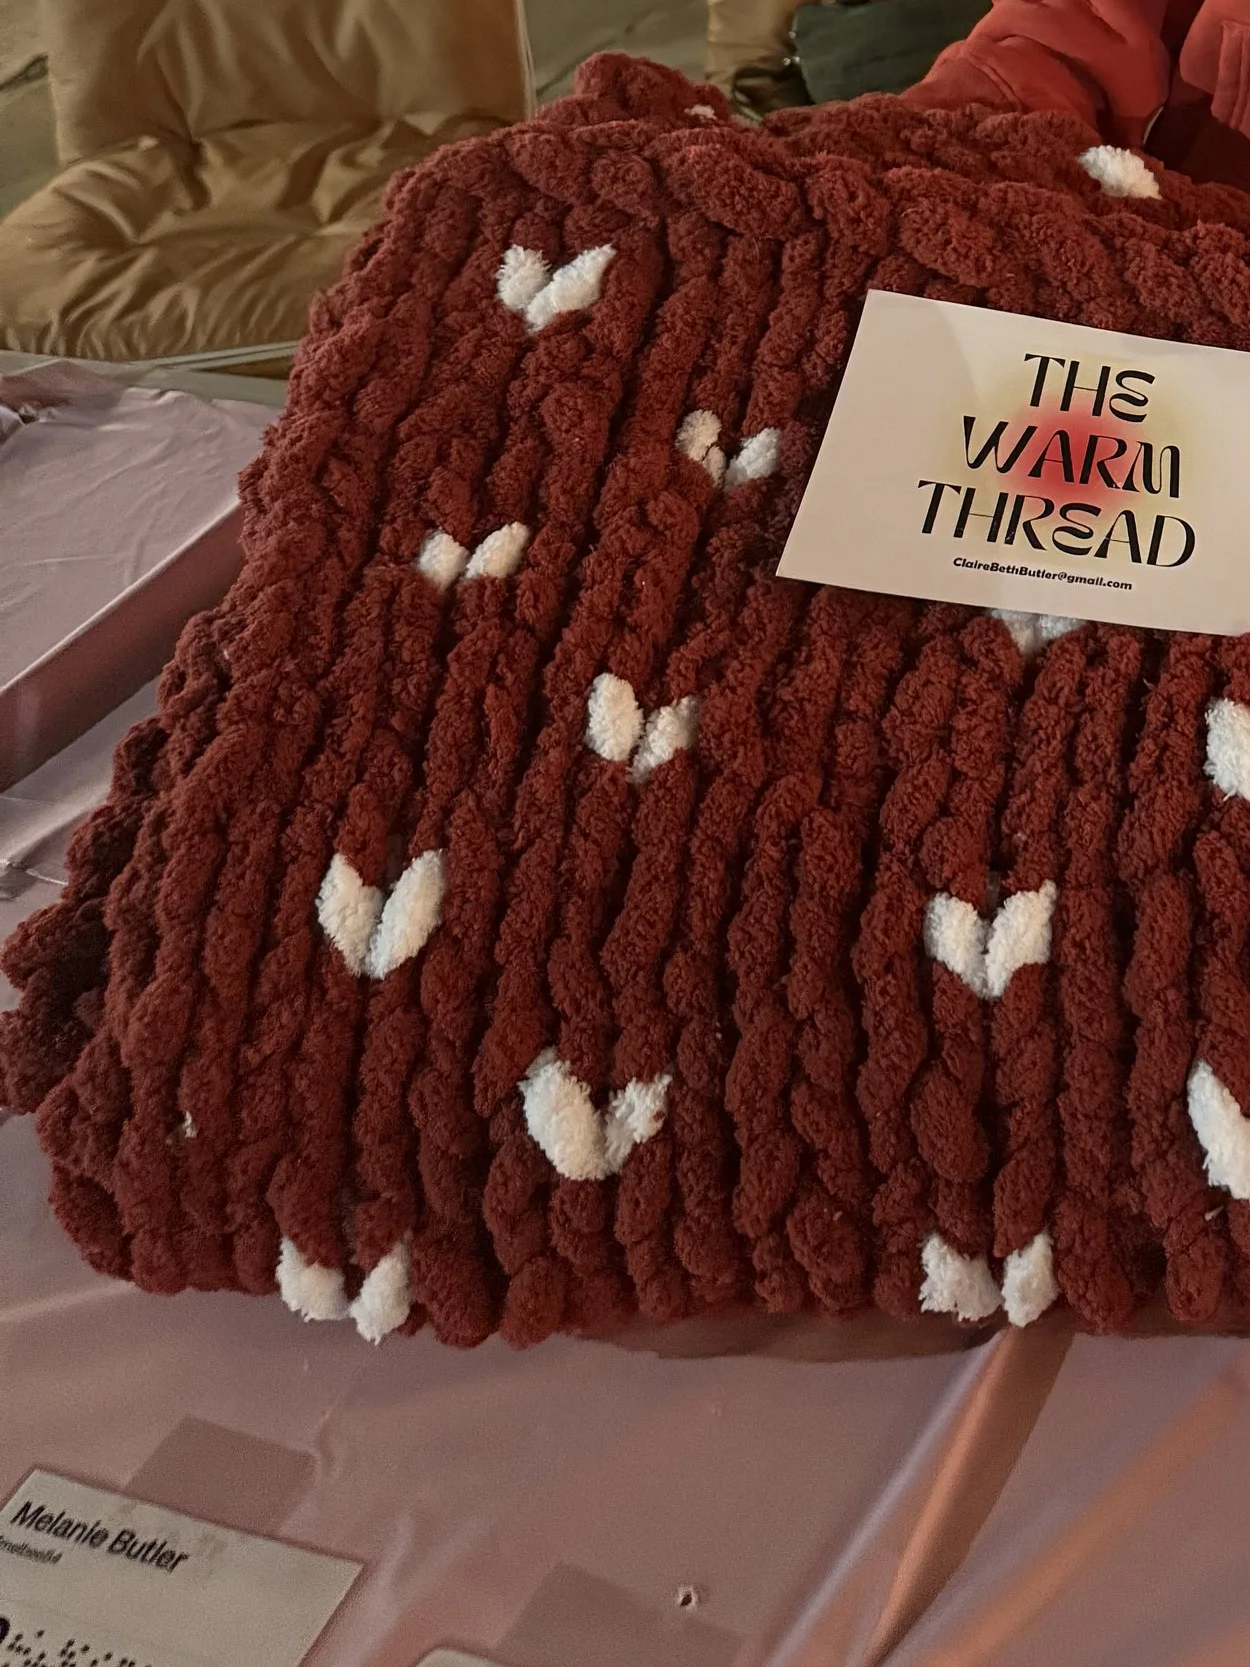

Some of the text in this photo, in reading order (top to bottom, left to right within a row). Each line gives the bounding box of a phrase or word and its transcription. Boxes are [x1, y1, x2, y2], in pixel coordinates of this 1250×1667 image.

[1024, 353, 1156, 423] THE
[963, 415, 1181, 499] WARM
[917, 480, 1197, 568] THREAD
[952, 556, 1133, 591] ClaireBethButler@gmail.com
[11, 1500, 109, 1548] Melanie
[108, 1528, 190, 1573] Butler
